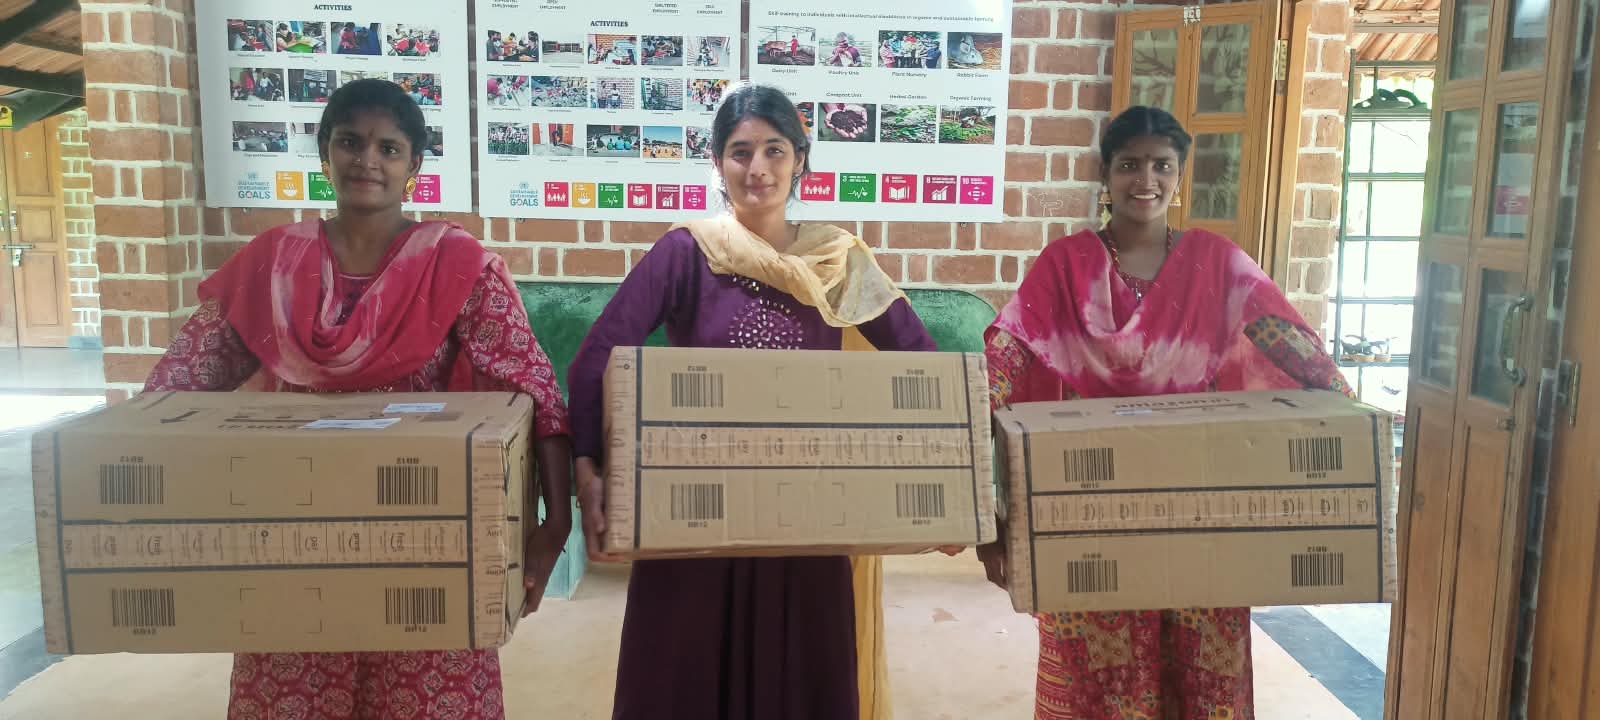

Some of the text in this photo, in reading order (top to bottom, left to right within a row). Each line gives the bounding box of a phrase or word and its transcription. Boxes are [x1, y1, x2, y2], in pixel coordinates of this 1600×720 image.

[885, 175, 890, 183] 4
[962, 177, 970, 185] 10
[238, 191, 271, 199] GOALS
[510, 199, 539, 207] GOALS
